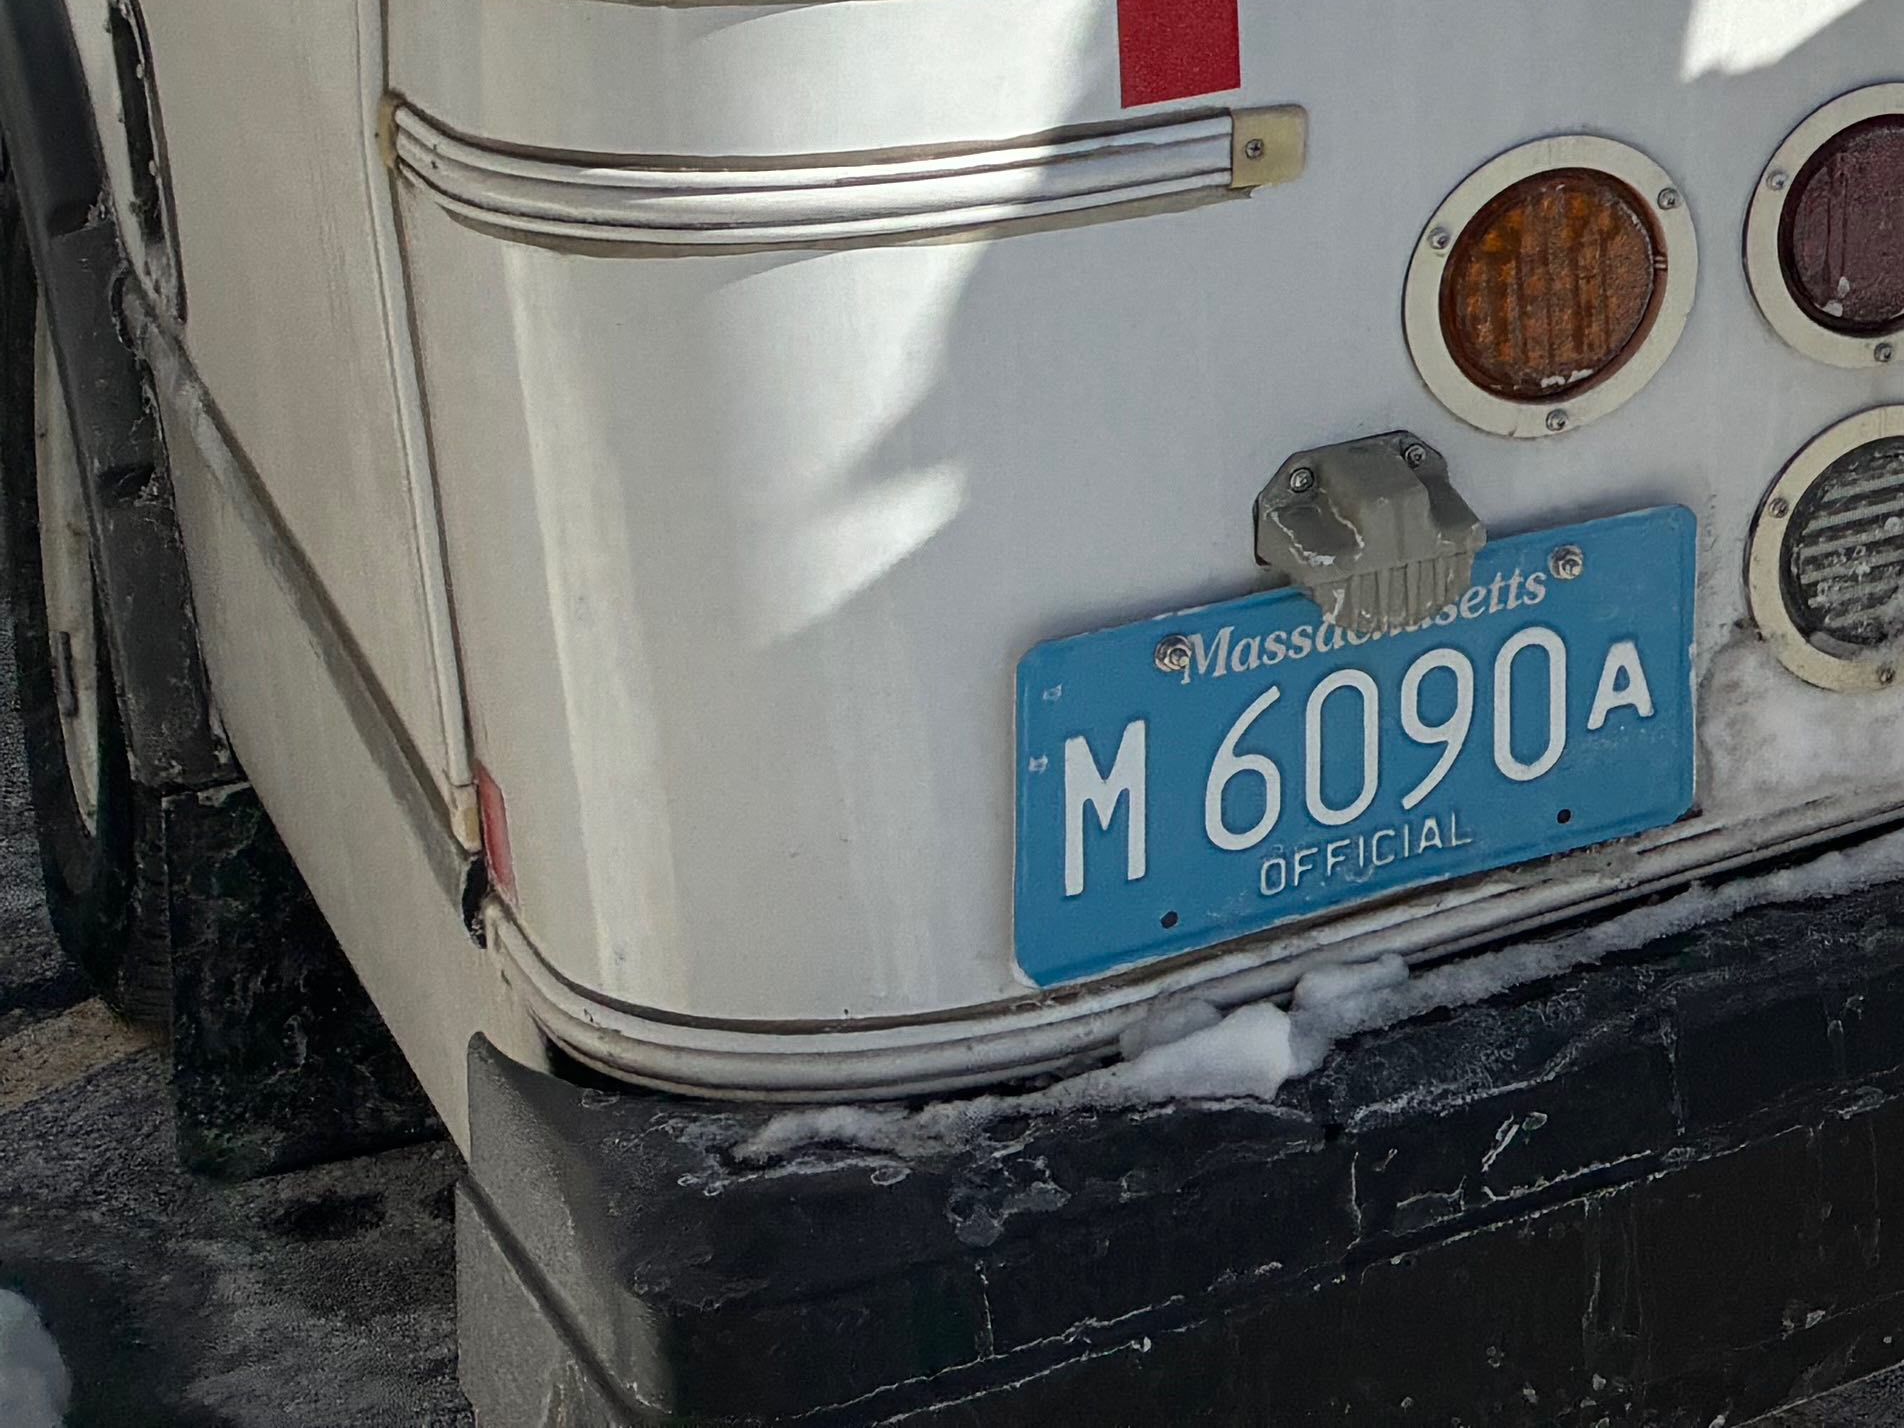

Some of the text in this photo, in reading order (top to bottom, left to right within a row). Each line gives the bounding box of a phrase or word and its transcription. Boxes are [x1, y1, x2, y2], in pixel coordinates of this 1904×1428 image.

[1180, 566, 1548, 685] Massacsetts
[1063, 719, 1147, 897] M
[1259, 815, 1473, 897] OFFICIAL
